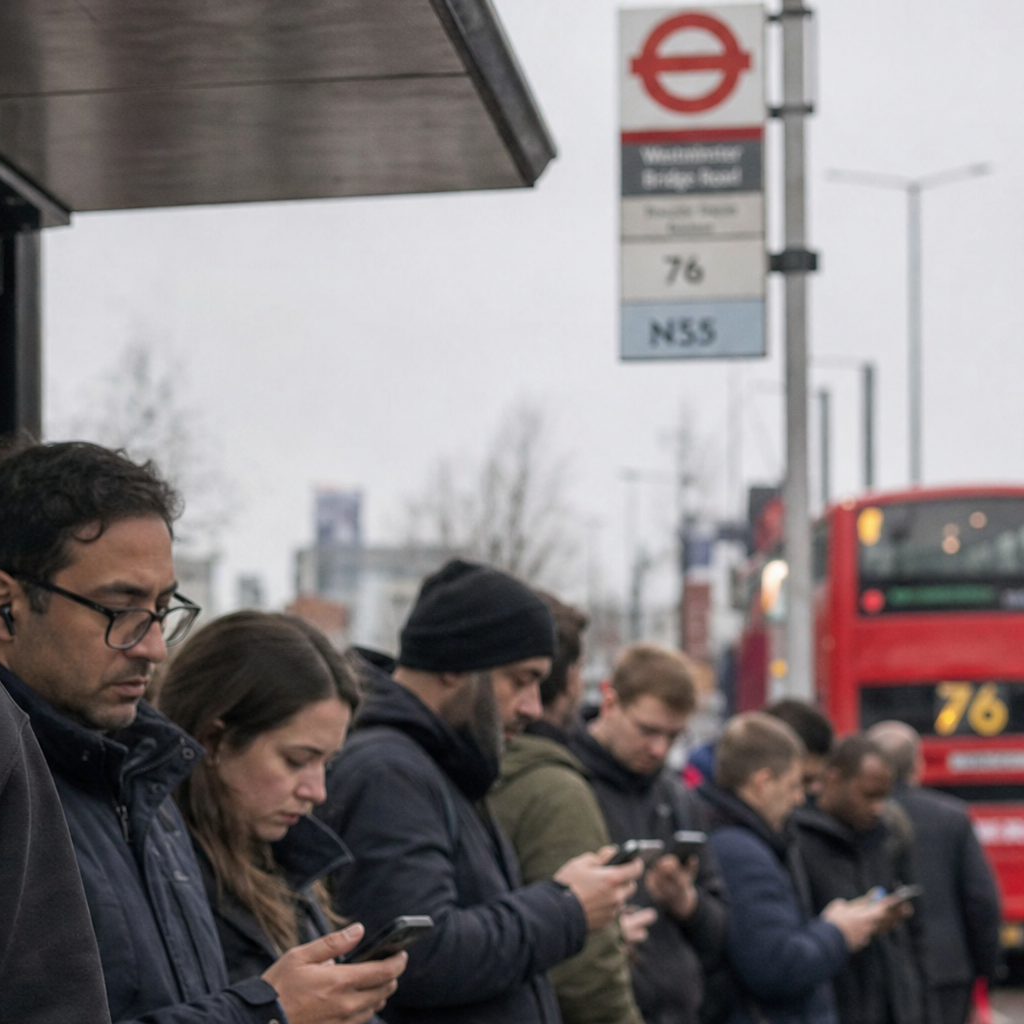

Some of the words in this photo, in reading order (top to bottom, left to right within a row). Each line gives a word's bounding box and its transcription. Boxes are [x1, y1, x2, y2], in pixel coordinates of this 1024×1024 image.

[664, 256, 705, 286] 76
[649, 318, 717, 348] N55
[934, 682, 1009, 736] 76
